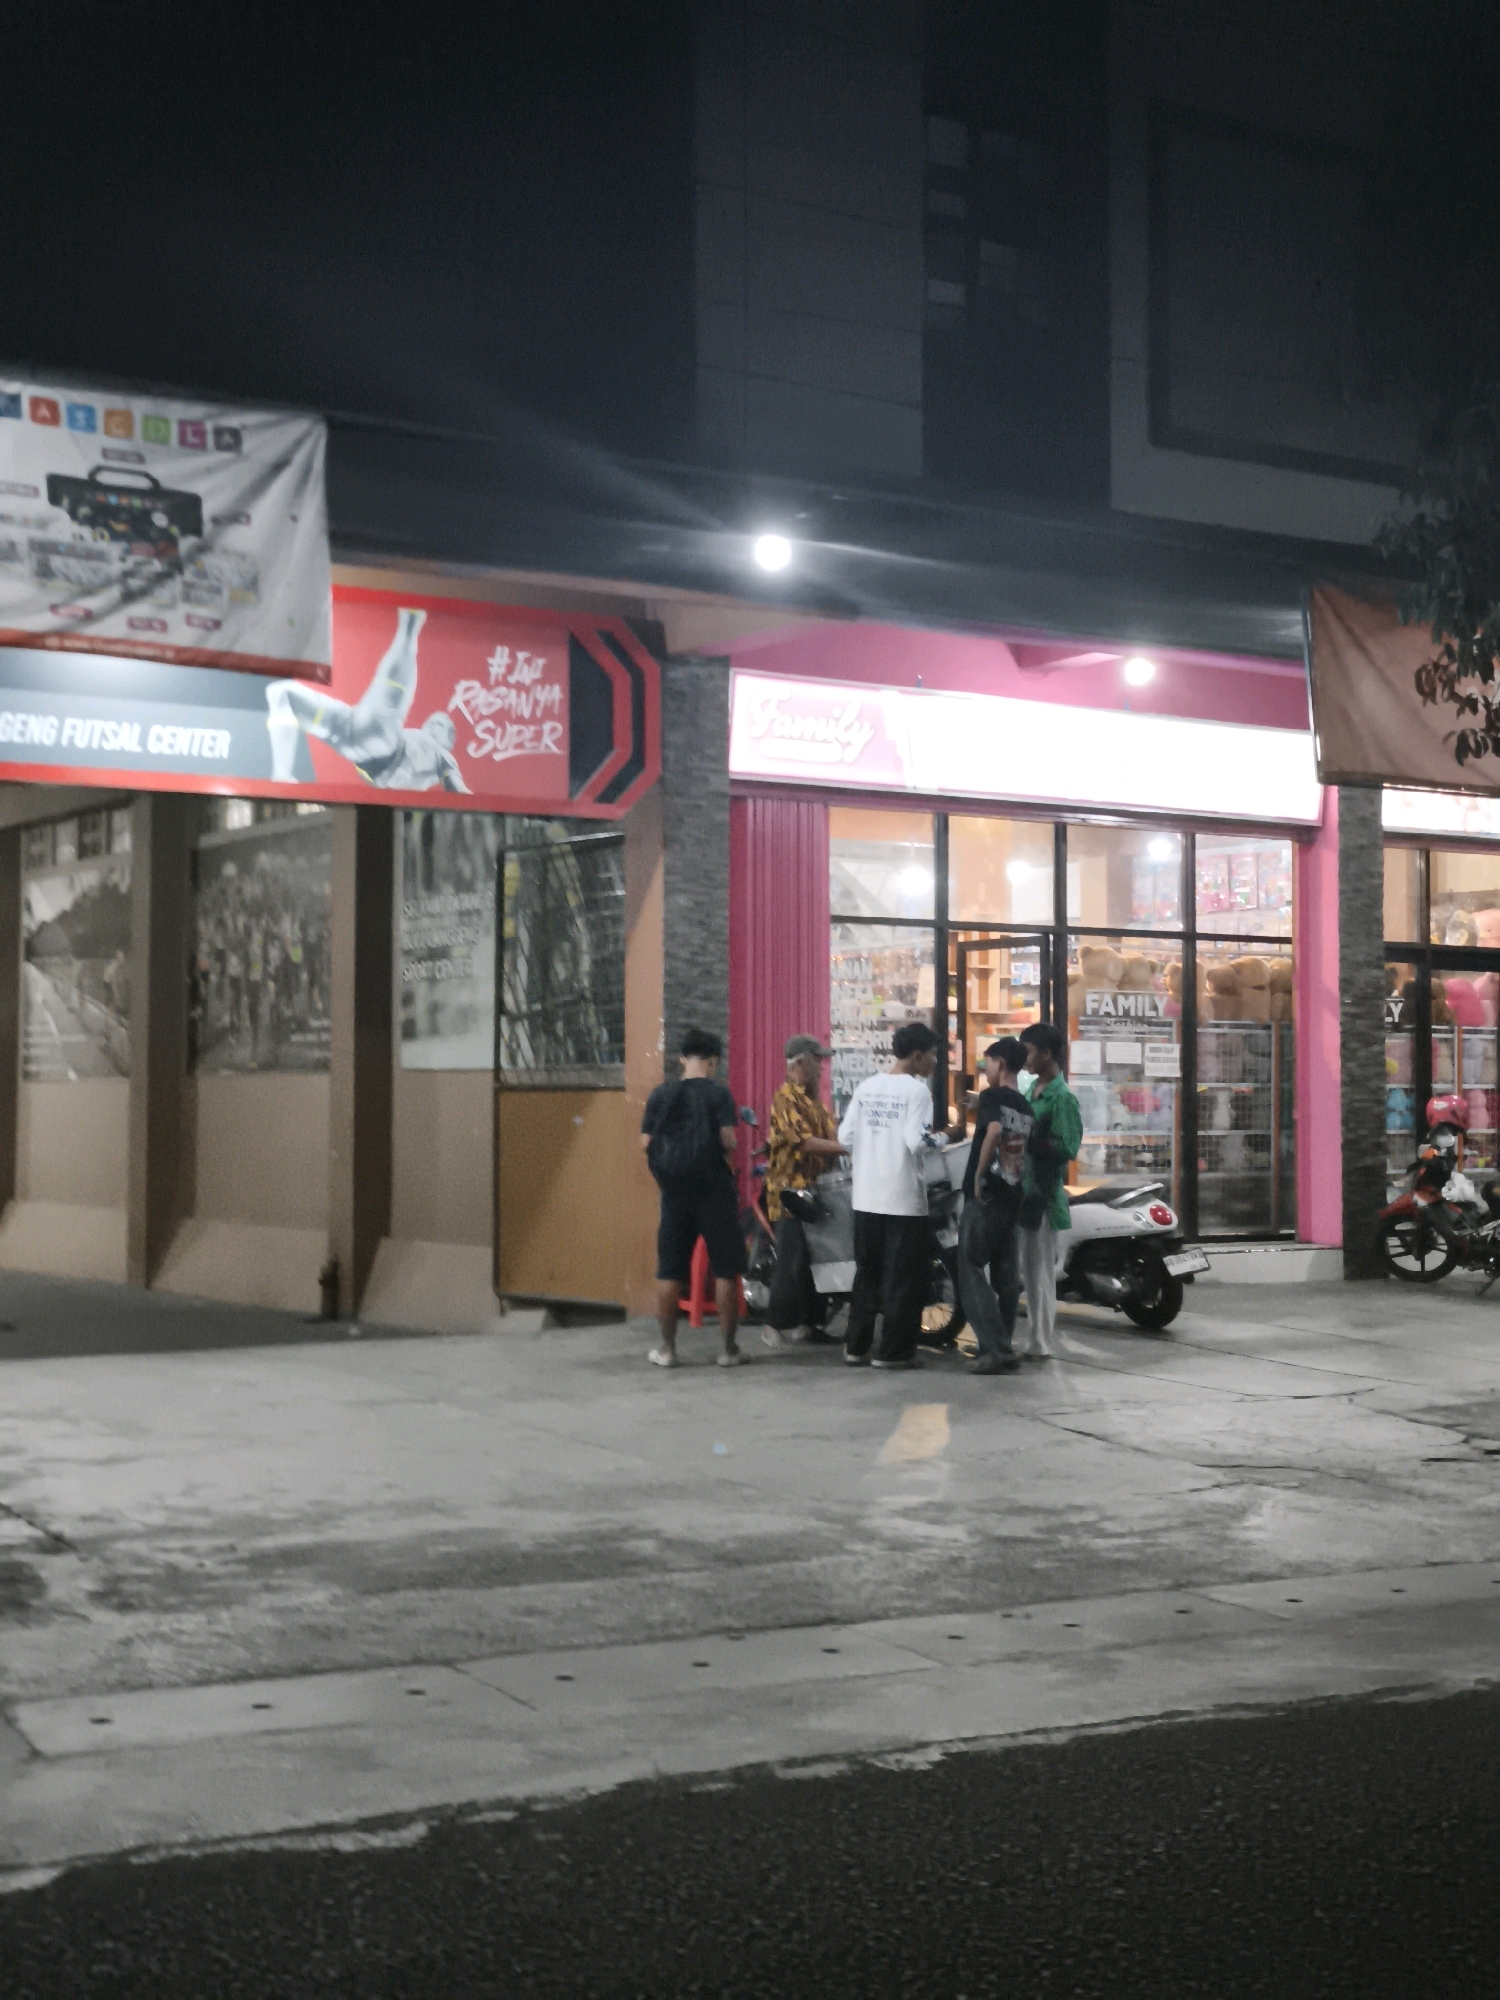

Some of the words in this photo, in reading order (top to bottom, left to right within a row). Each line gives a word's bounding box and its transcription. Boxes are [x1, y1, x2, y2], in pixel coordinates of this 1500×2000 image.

[447, 680, 563, 726] RASANYA
[61, 717, 142, 752] FUTSAL
[147, 724, 231, 759] CENTER
[466, 719, 566, 761] SUPER
[748, 690, 876, 764] Family
[1085, 993, 1169, 1017] FAMILY
